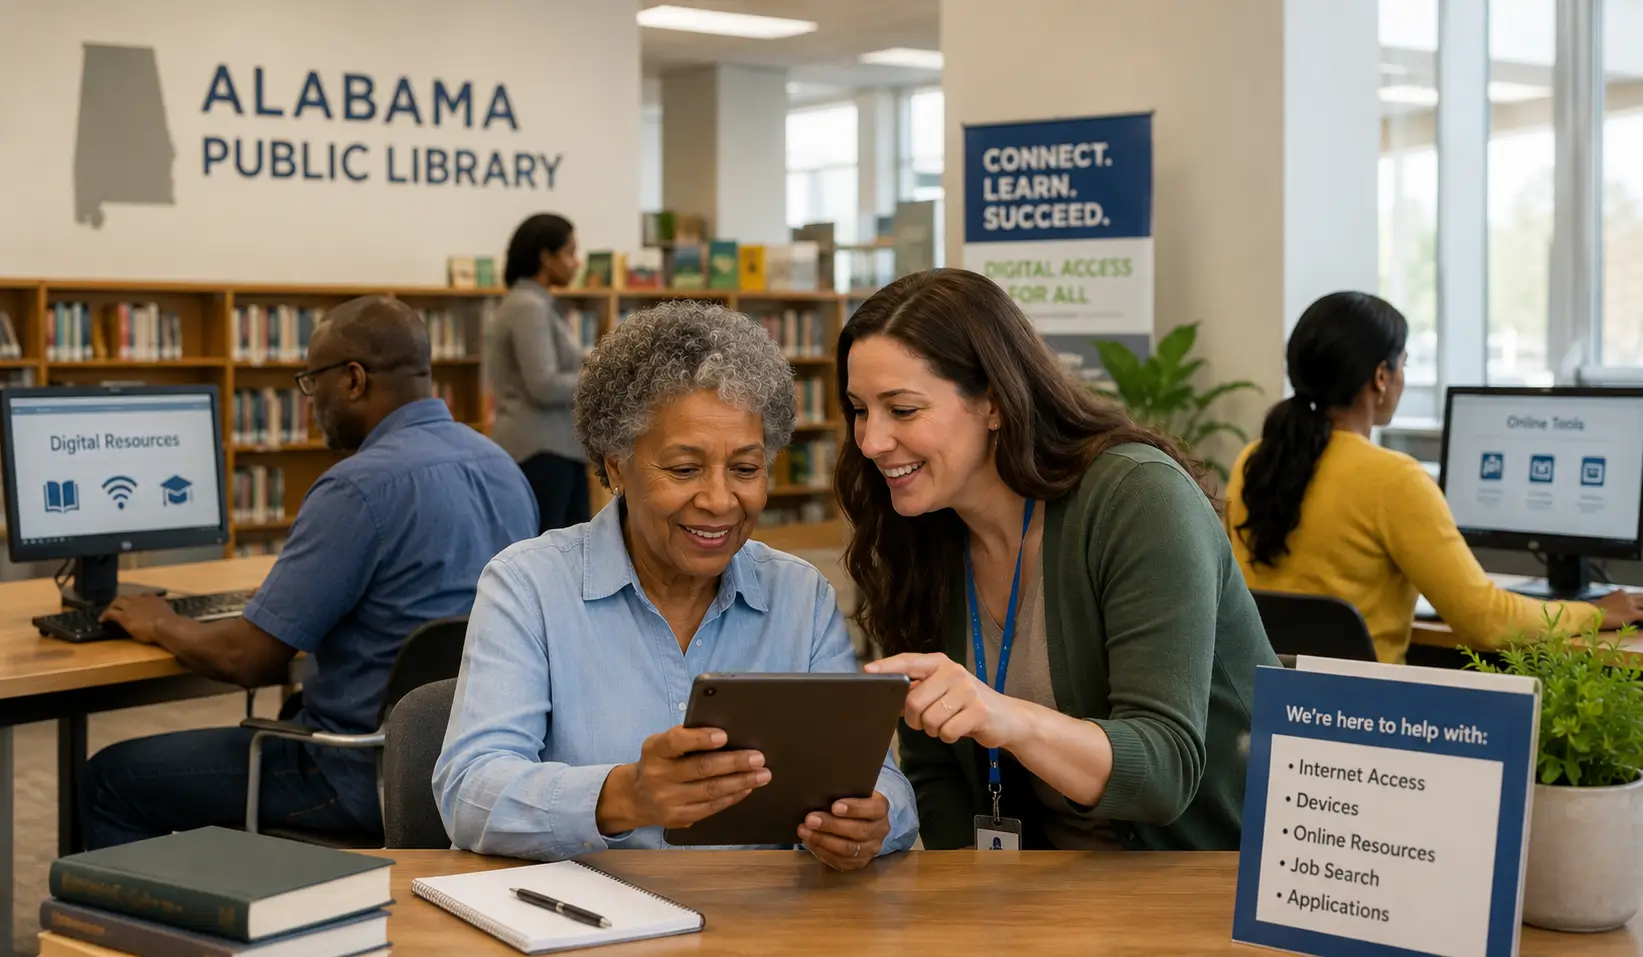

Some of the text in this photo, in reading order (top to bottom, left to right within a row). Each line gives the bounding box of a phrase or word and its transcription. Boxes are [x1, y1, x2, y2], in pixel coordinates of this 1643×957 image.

[201, 63, 520, 131] ALABAMA
[202, 136, 563, 190] PUBLIC LIBRARY
[983, 142, 1113, 172] CONNECT.
[983, 174, 1077, 201] LEARN.
[983, 202, 1110, 230] SUCCEED.
[984, 257, 1133, 280] DIGITAL ACCESS
[1008, 284, 1090, 304] FOR ALL
[1506, 414, 1585, 431] Online Tools
[50, 433, 180, 454] Digital Resources
[1286, 704, 1488, 745] We're here to help with:
[1299, 759, 1426, 791] Internet Access
[1296, 792, 1359, 816] Devices
[1293, 825, 1435, 862] Online Resources
[1290, 857, 1380, 886] Job Search
[1286, 889, 1390, 922] Applications
